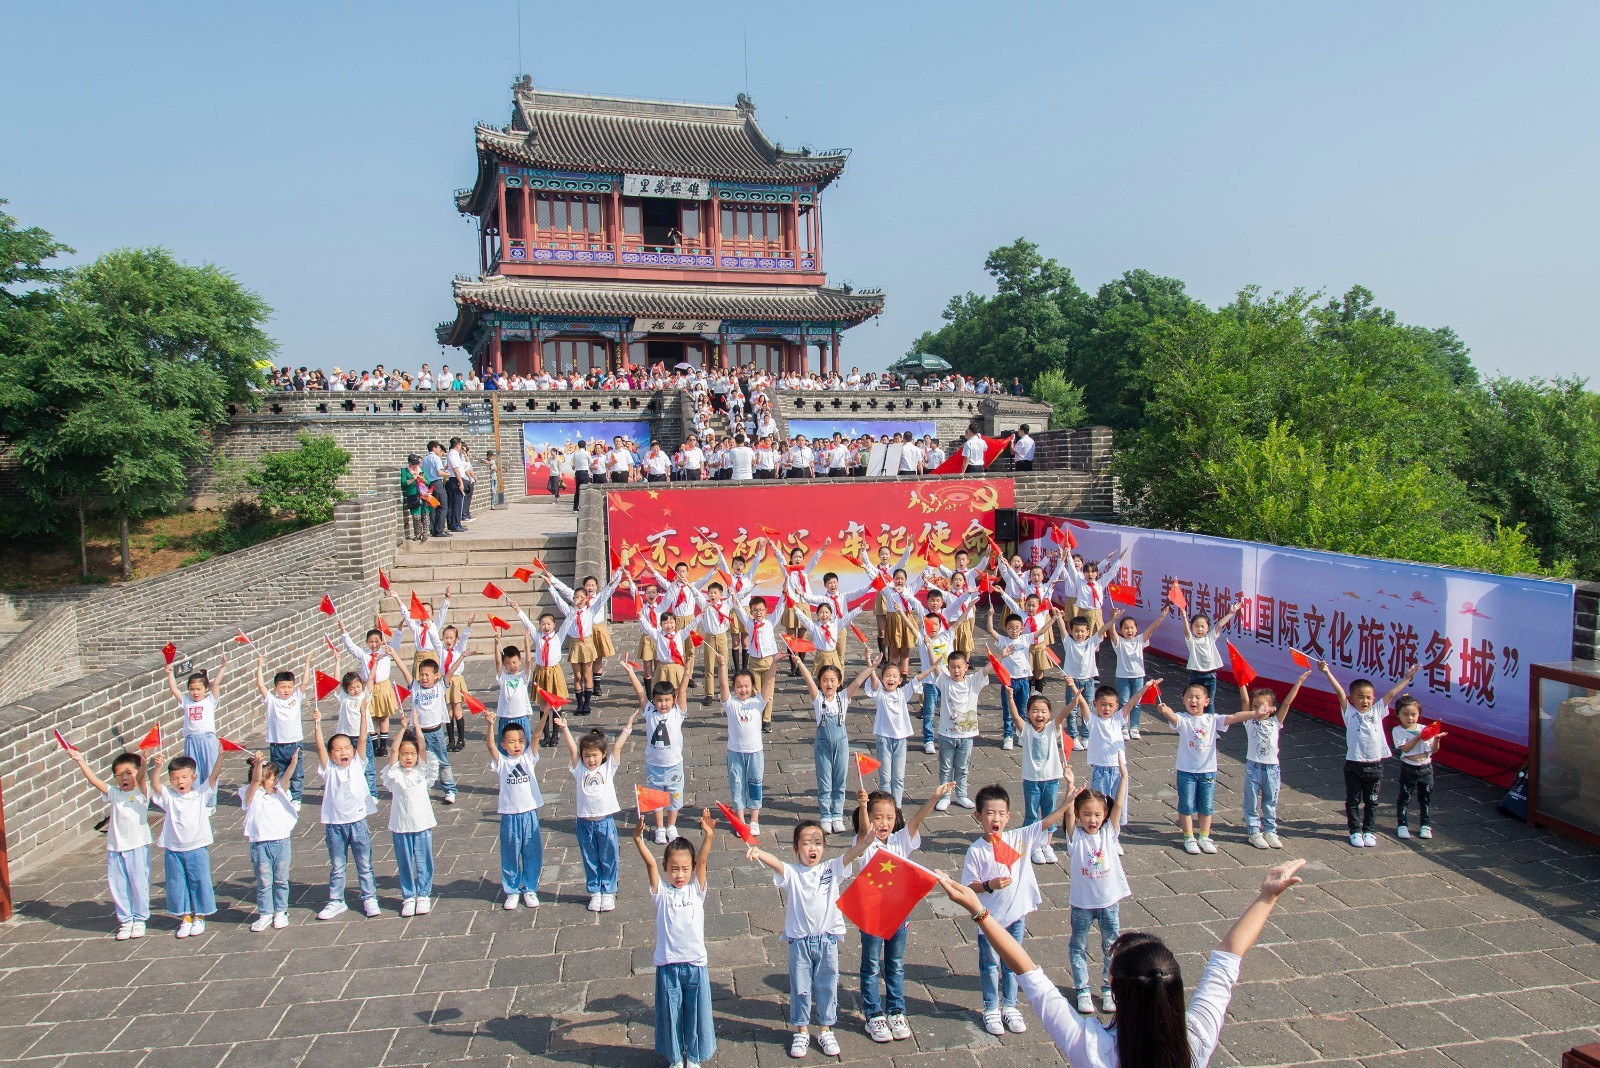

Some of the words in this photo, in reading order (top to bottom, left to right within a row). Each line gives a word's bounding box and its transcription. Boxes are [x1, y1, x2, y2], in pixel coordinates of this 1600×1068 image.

[647, 526, 810, 567] 不忘初心
[838, 518, 994, 558] 牢记使命
[650, 719, 671, 747] A
[506, 775, 531, 785] adidas
